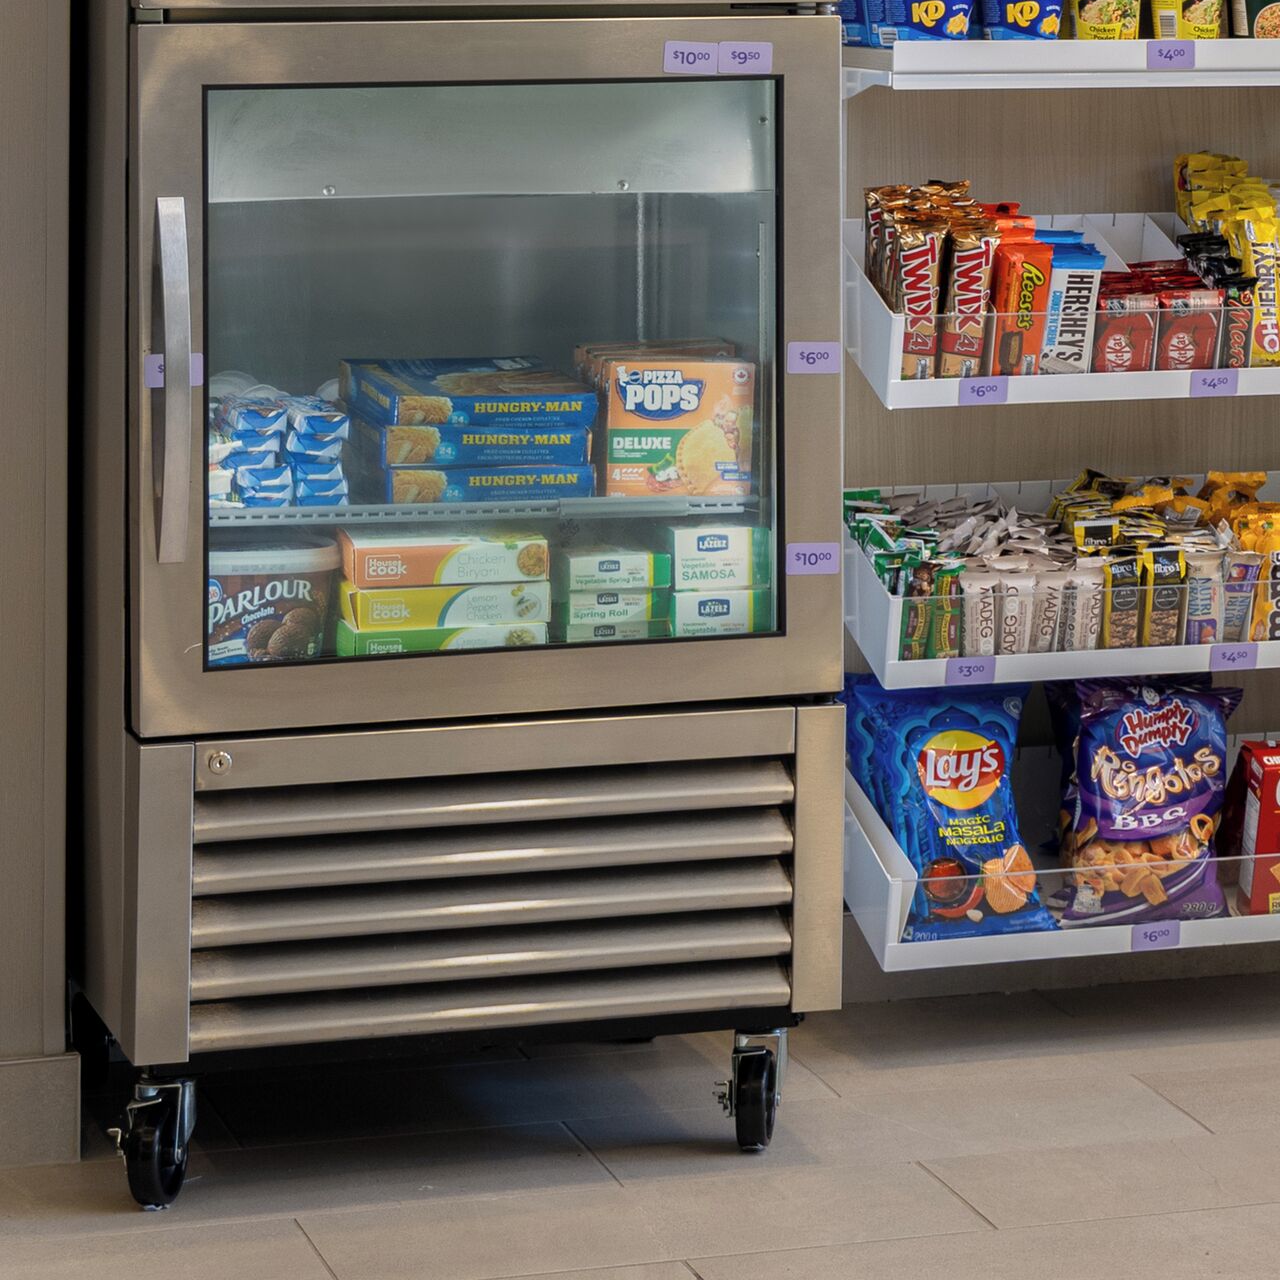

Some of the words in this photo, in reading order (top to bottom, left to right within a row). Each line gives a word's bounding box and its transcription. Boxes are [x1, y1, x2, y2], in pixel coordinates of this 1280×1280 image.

[1089, 26, 1116, 34] Chicken
[900, 234, 938, 331] TWIX
[1056, 273, 1095, 365] HERSHEY'S
[1228, 299, 1251, 368] Mars
[643, 369, 683, 384] PIZZA
[474, 400, 582, 414] HUNGRY-MAN
[625, 383, 702, 411] POPS
[613, 436, 672, 451] DELUXE
[682, 570, 736, 581] SAMOSA
[1124, 700, 1193, 735] Humpty
[1122, 721, 1192, 756] Dumpty
[926, 745, 999, 792] Lay's
[1091, 745, 1220, 804] Ringolos
[1110, 807, 1187, 831] BBQ
